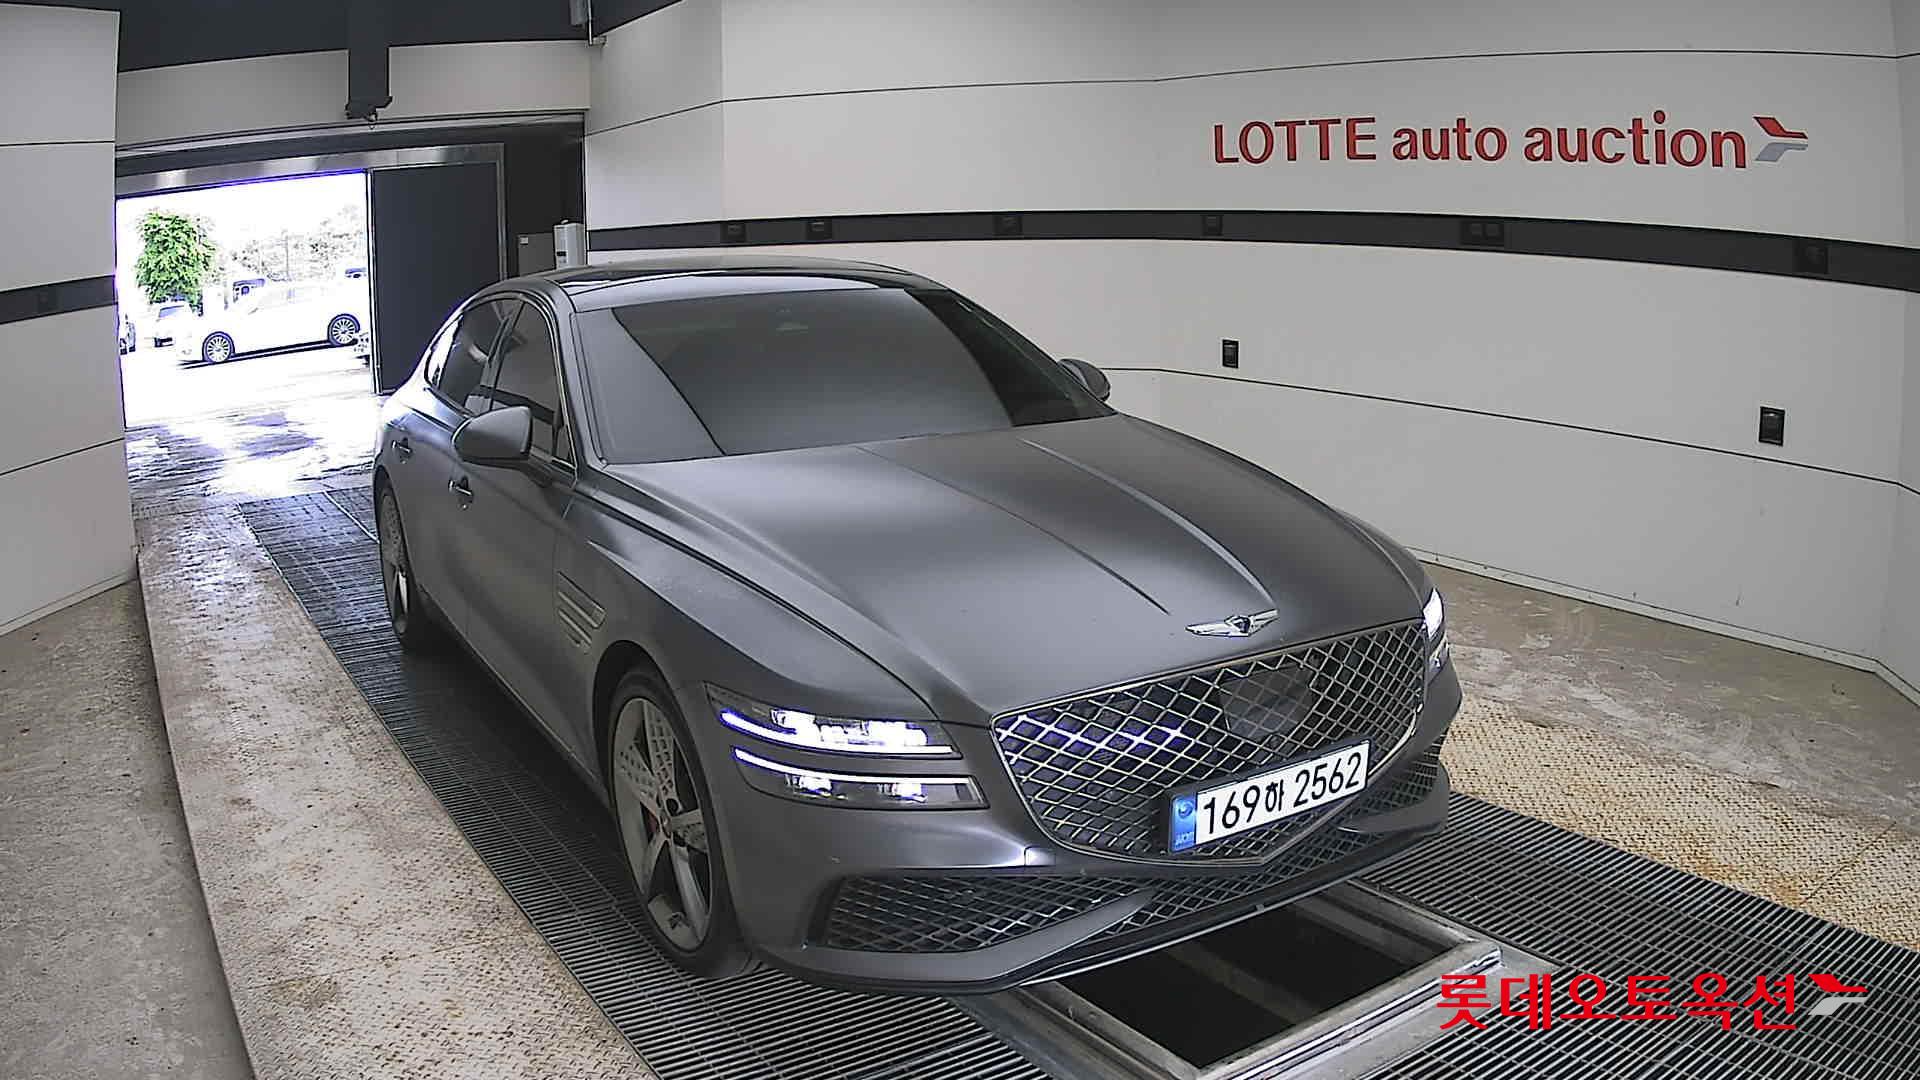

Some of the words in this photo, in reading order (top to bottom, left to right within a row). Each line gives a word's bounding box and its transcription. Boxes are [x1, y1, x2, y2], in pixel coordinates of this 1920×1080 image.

[1213, 117, 1377, 164] LOTTE
[1392, 117, 1507, 162] auto
[1523, 110, 1747, 169] auction
[1203, 779, 1285, 835] 169하
[1293, 751, 1362, 807] 2562
